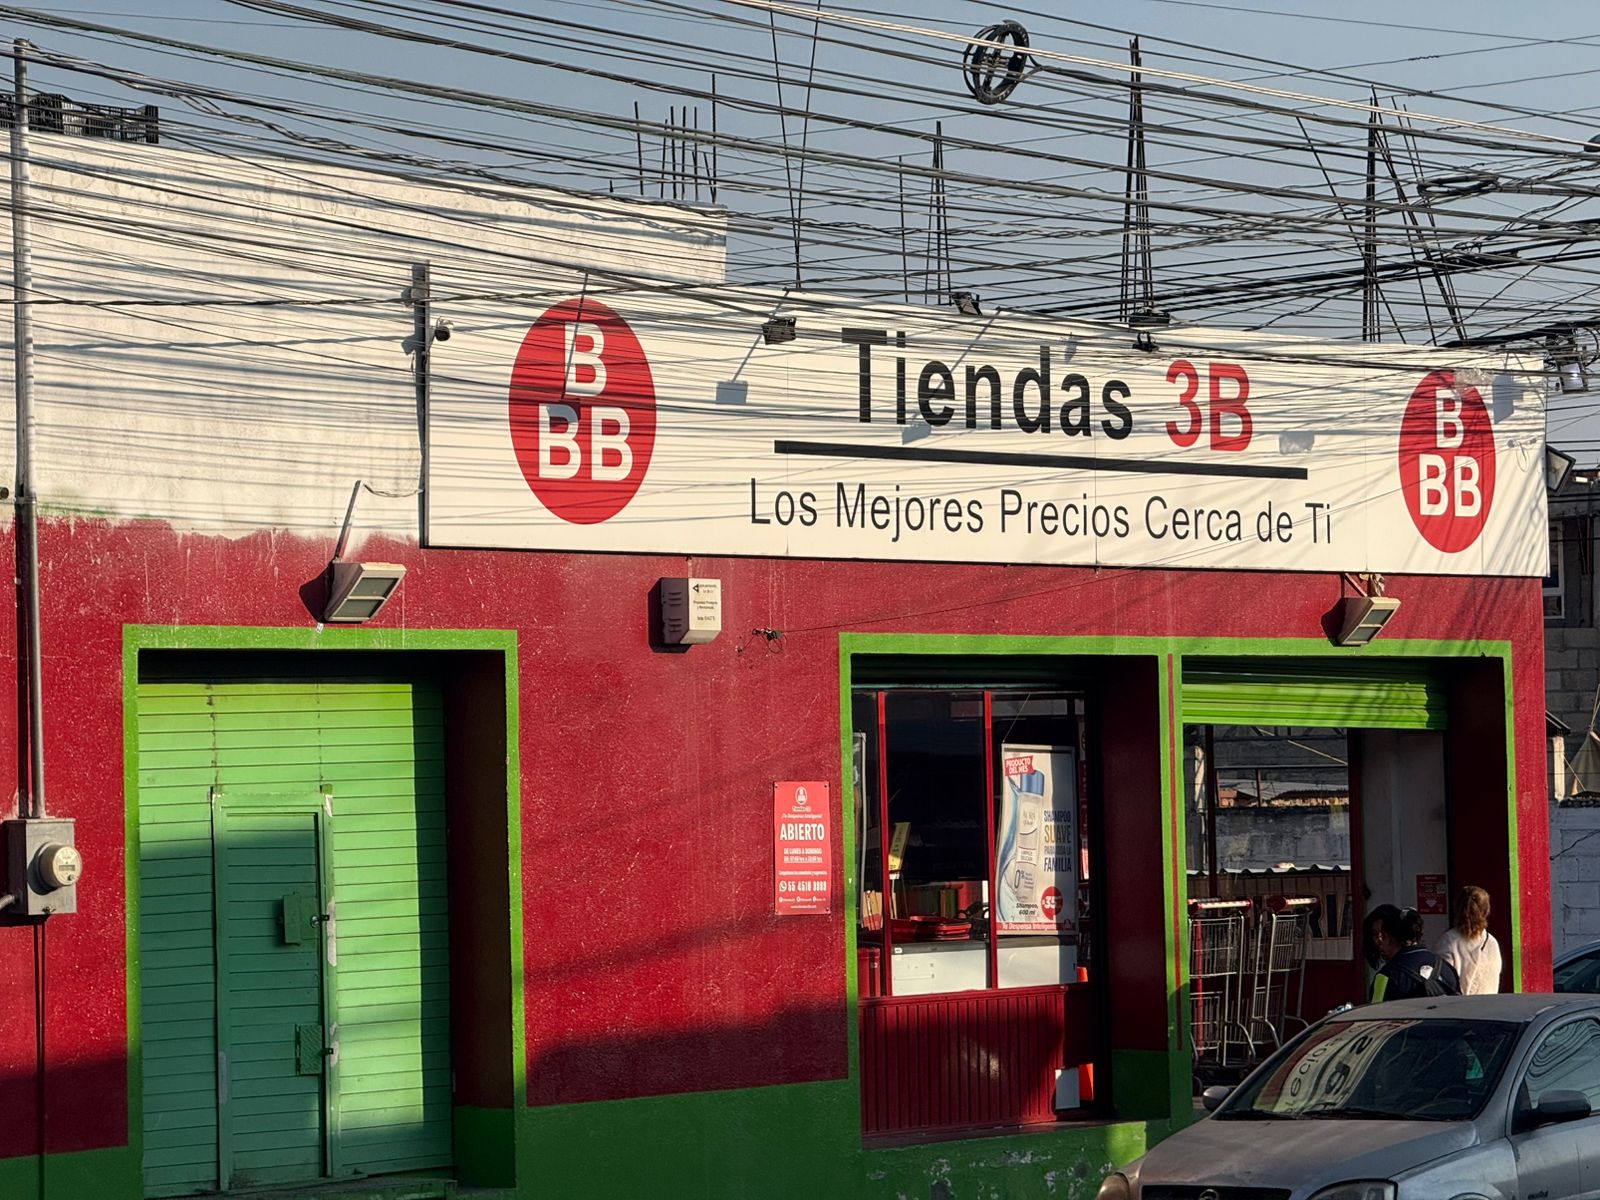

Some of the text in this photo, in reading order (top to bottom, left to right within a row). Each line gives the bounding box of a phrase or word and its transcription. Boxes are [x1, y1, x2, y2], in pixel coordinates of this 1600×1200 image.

[565, 321, 607, 397] B
[842, 328, 1253, 452] Tiendas 3B
[539, 403, 633, 481] BB
[1436, 387, 1464, 448] B
[751, 478, 1331, 543] Los Mejores Precios Cerca de Ti
[1419, 454, 1482, 517] BB
[780, 823, 825, 840] ABIERTO
[1043, 810, 1071, 822] SHAMPOO
[1044, 824, 1071, 843] SUAVE
[1043, 857, 1072, 872] FAMILIA
